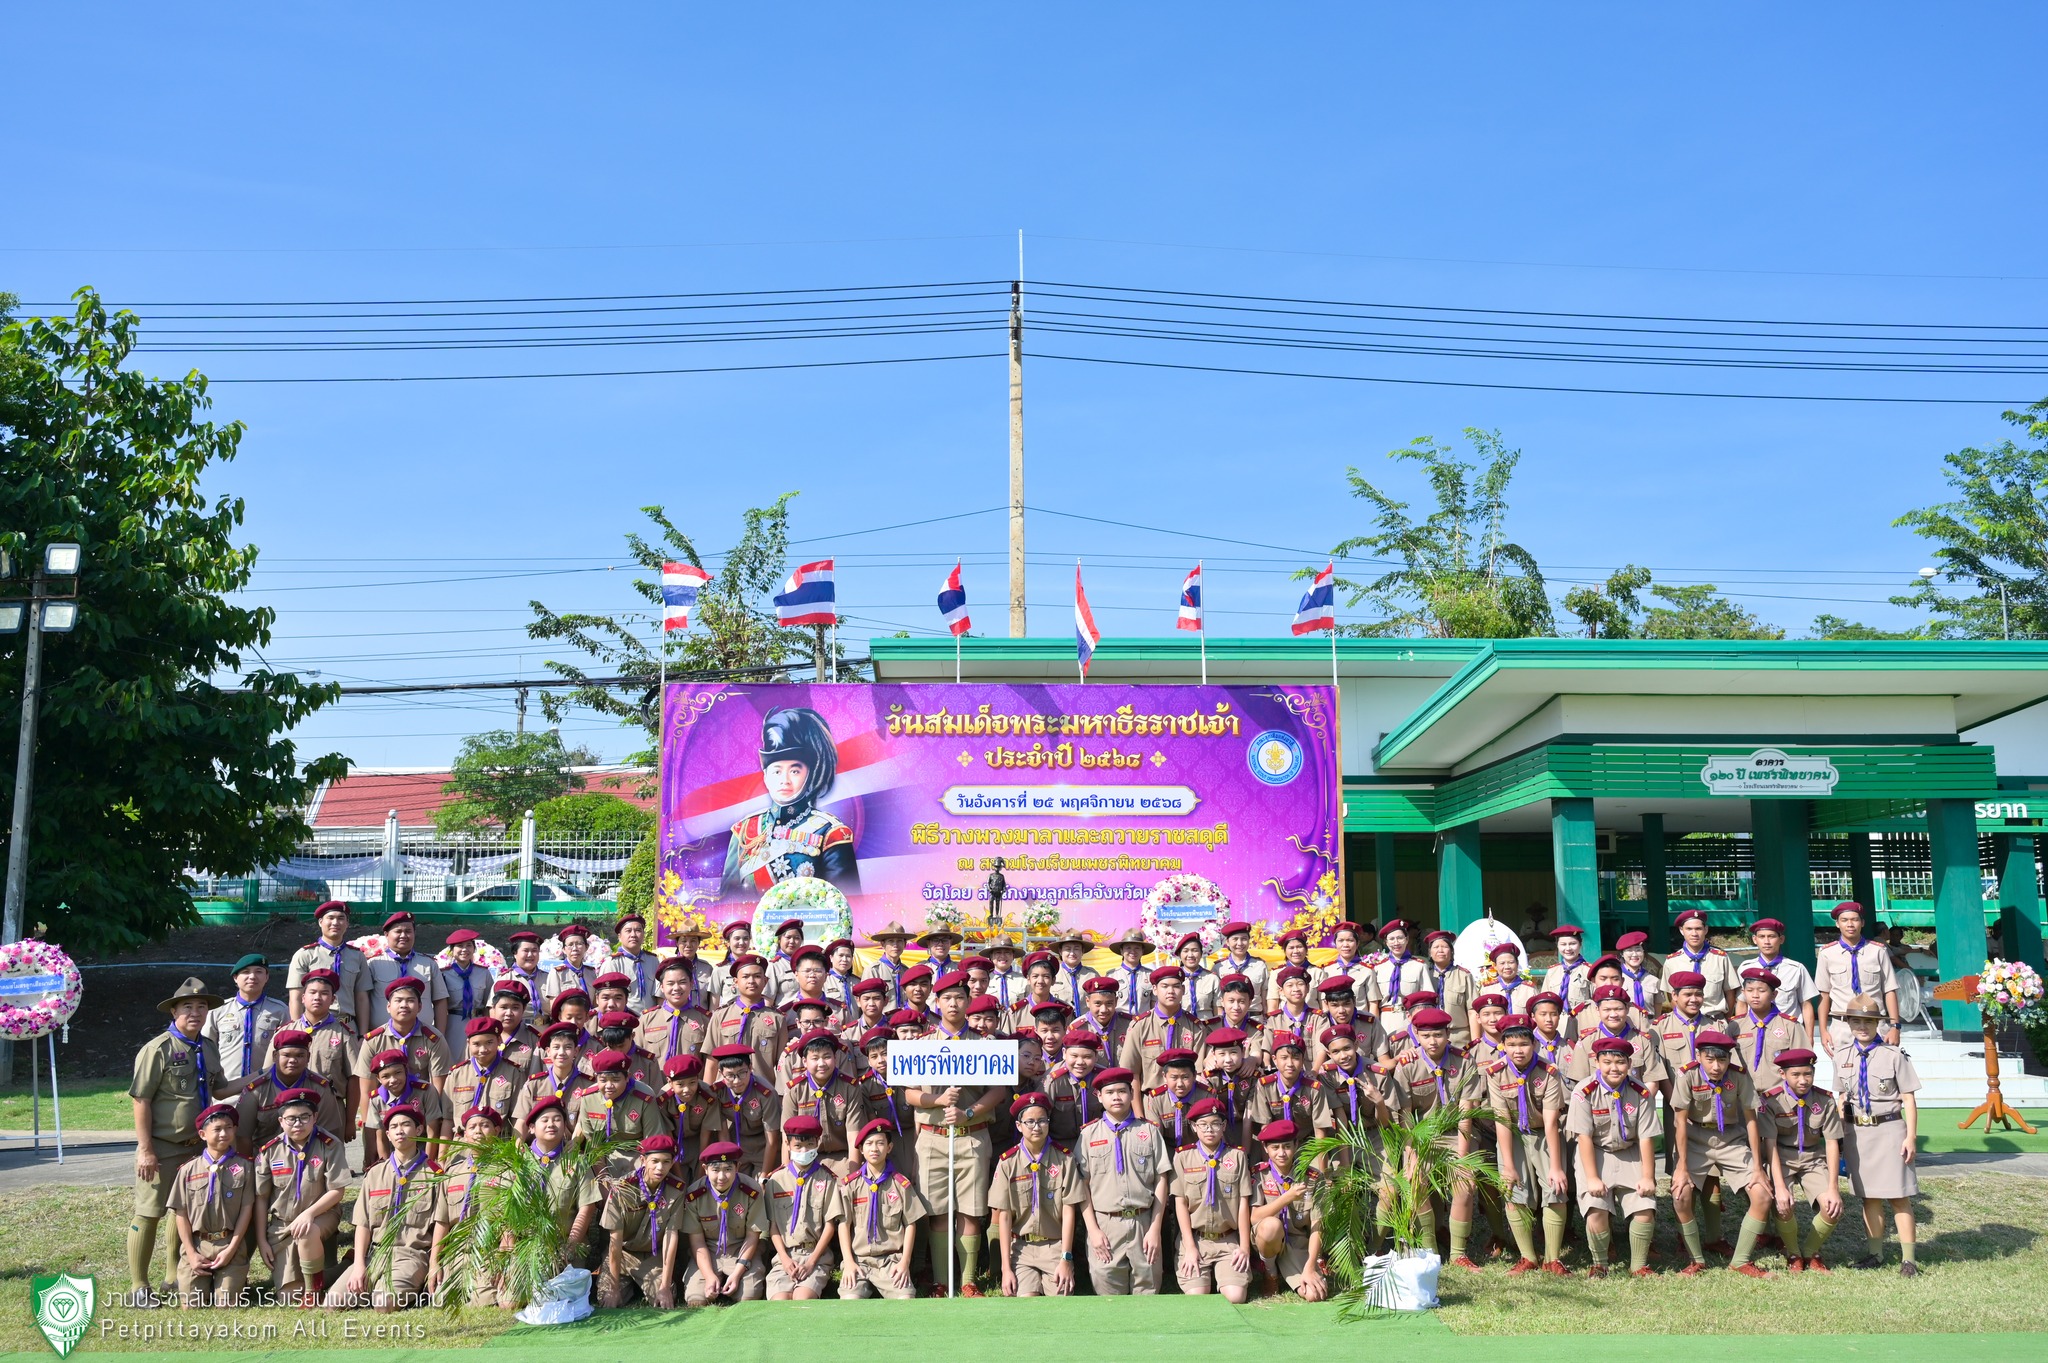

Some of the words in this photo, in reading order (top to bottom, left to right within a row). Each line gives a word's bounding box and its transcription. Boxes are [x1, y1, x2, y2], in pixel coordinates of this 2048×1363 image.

[885, 702, 1241, 737] วันสมเด็จพระมหาธีรราชเจ้า
[984, 743, 1074, 768] ประจำปี
[1079, 747, 1142, 769] ๒๕๖๘
[1735, 768, 1747, 781] ปี
[1748, 768, 1832, 781] เพชรพิทยาคม
[956, 790, 1028, 809] วันอังคารที่
[1033, 796, 1053, 809] ๒๕
[1060, 794, 1135, 812] พฤศจิกายน
[1140, 796, 1182, 809] ๒๕๖๘
[911, 821, 1229, 852] พิธีวางพวงมาลาและถวายราชสดุดี
[957, 858, 974, 871] ณ
[922, 882, 971, 901] จัดโดย
[892, 1045, 1015, 1076] เพชรพิทยาคม
